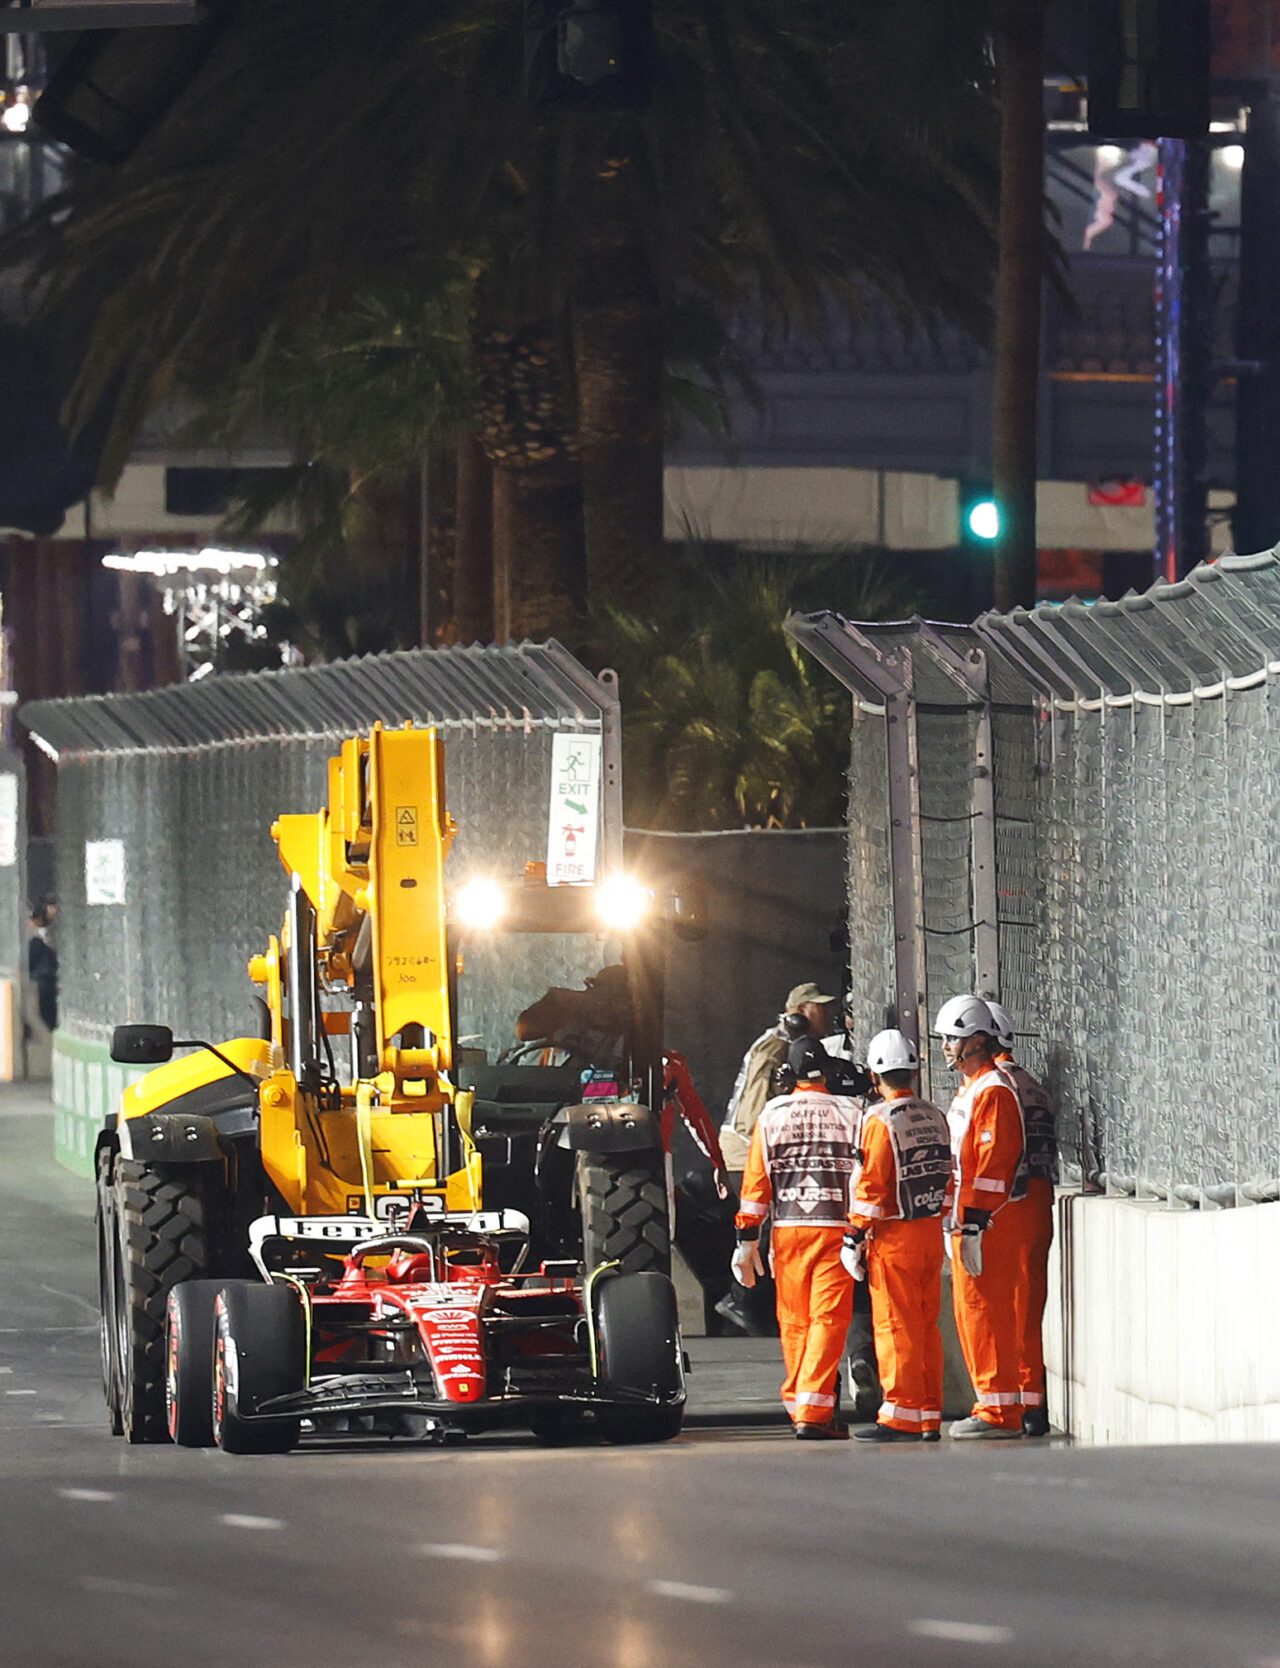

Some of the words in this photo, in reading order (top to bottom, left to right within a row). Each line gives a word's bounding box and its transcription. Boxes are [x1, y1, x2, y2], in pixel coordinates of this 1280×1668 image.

[558, 783, 590, 795] EXIT
[555, 863, 585, 875] FIRE
[778, 1187, 843, 1202] COURSE
[294, 1216, 487, 1239] Feri
